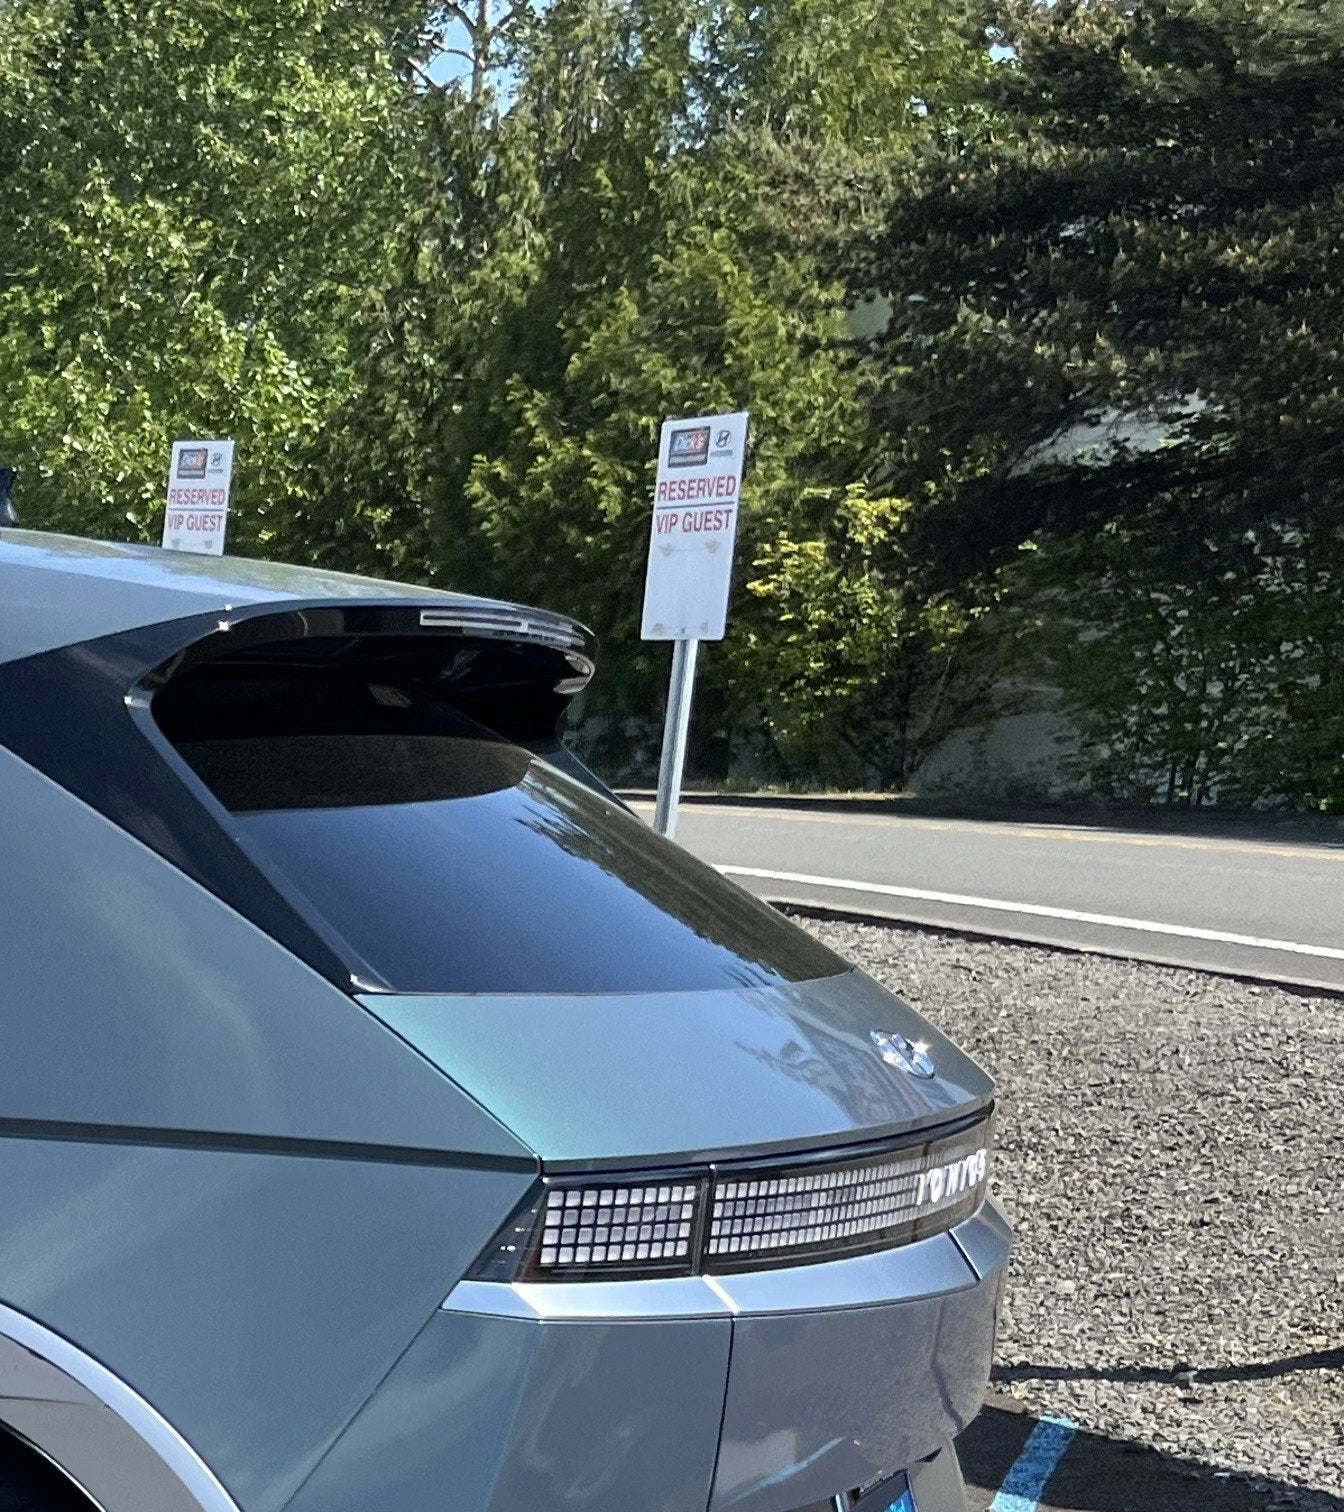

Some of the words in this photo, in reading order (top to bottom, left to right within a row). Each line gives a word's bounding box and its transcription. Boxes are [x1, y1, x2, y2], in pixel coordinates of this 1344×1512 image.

[169, 488, 226, 506] RESERVED
[657, 475, 736, 501] RESERVED
[168, 514, 184, 530] VIP
[186, 514, 223, 532] GUEST
[655, 513, 679, 535] VIP
[682, 509, 733, 533] GUEST
